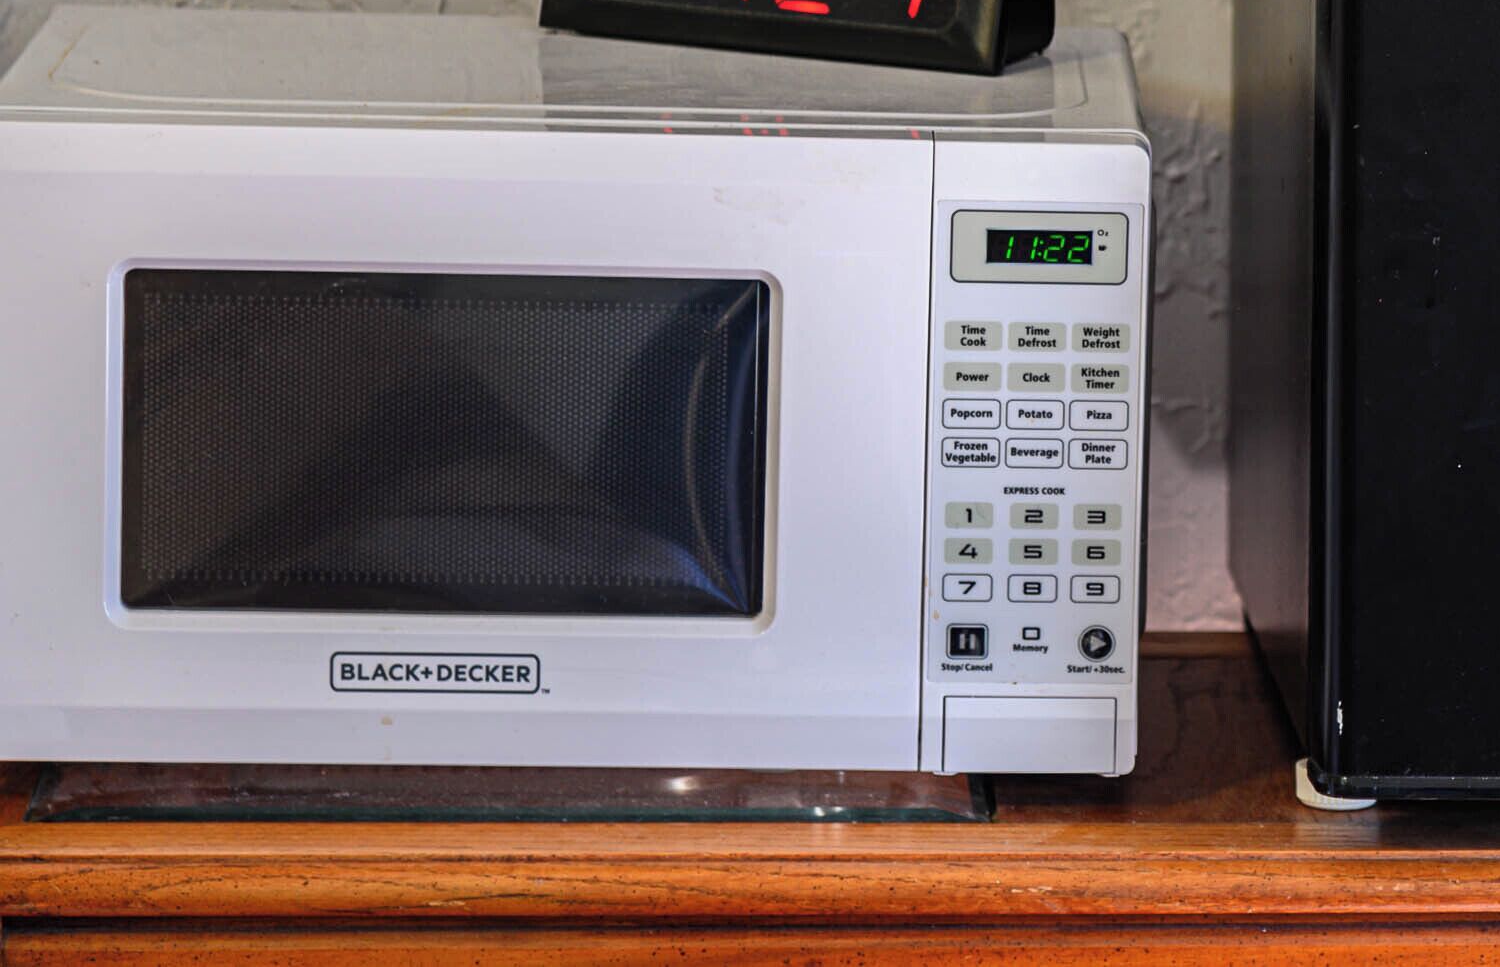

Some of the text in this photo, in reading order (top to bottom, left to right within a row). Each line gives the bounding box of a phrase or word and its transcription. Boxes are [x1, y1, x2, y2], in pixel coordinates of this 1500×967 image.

[1005, 235, 1090, 263] 11:22
[960, 325, 987, 335] Time
[1024, 326, 1050, 336] Time
[1082, 327, 1120, 339] Weight
[960, 337, 987, 347] Cook
[1017, 337, 1057, 348] Defrost
[1082, 338, 1121, 349] Defrost
[955, 372, 989, 382] Power
[1022, 372, 1050, 383] Clock
[1081, 368, 1120, 378] Kitchen
[1085, 380, 1115, 389] Timer
[950, 408, 993, 420] Popcorn
[1018, 409, 1053, 419] Potato
[1086, 410, 1112, 420] Pizza
[953, 441, 988, 451] Frozen
[1081, 443, 1116, 452] Dinner
[945, 452, 997, 464] Vegetable
[1010, 447, 1059, 459] Beverage
[1085, 454, 1112, 464] Plate
[1003, 486, 1066, 496] EXPRESS COOK
[965, 508, 973, 523] 1
[1024, 509, 1044, 524] 2
[1087, 510, 1106, 524] 3
[958, 544, 978, 559] 4
[1023, 545, 1042, 559] 5
[1086, 546, 1105, 560] 6
[958, 581, 977, 595] 7
[1023, 582, 1042, 596] 8
[1085, 582, 1105, 596] 9
[1012, 644, 1048, 653] Memory
[340, 663, 531, 683] BLACK+DECKER
[964, 663, 993, 672] Cancel
